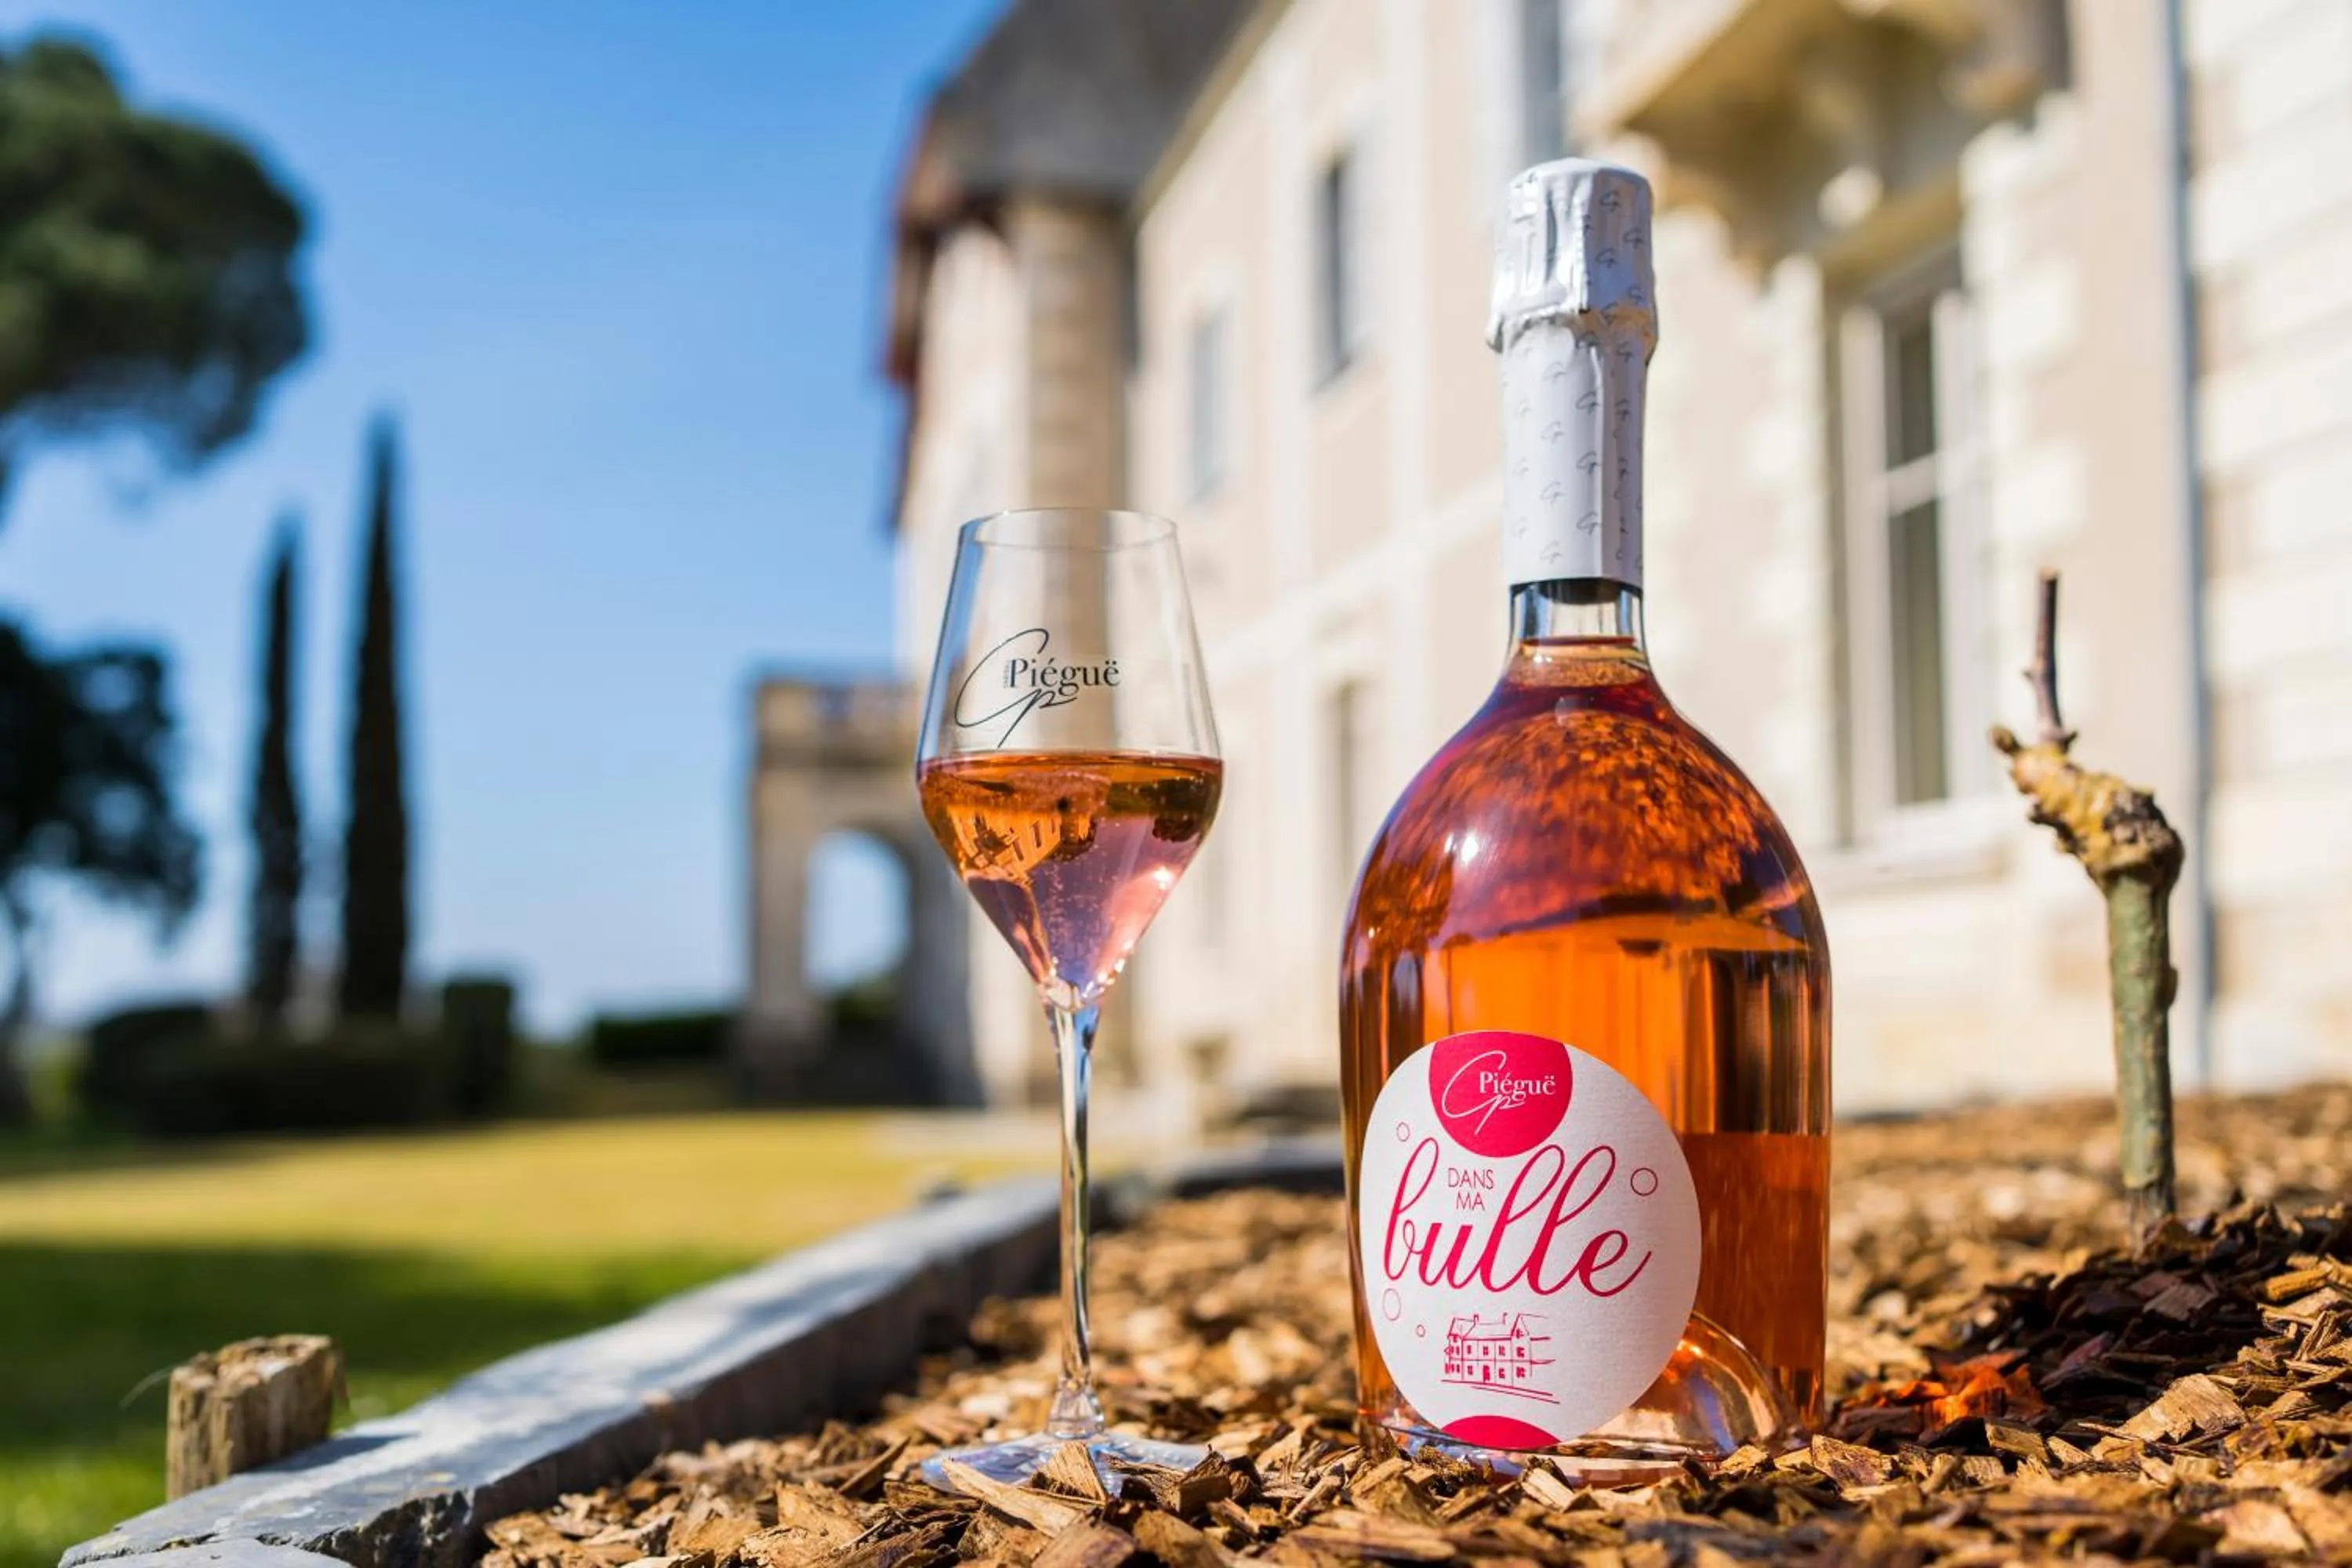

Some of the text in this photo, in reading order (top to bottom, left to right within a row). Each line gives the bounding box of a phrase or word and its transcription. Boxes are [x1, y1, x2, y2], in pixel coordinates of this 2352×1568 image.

[1009, 657, 1121, 696] Piéguë
[1479, 1070, 1556, 1102] Piéguë
[1447, 1167, 1494, 1189] DANS
[1456, 1191, 1486, 1210] MA
[1384, 1137, 1652, 1298] bulle
